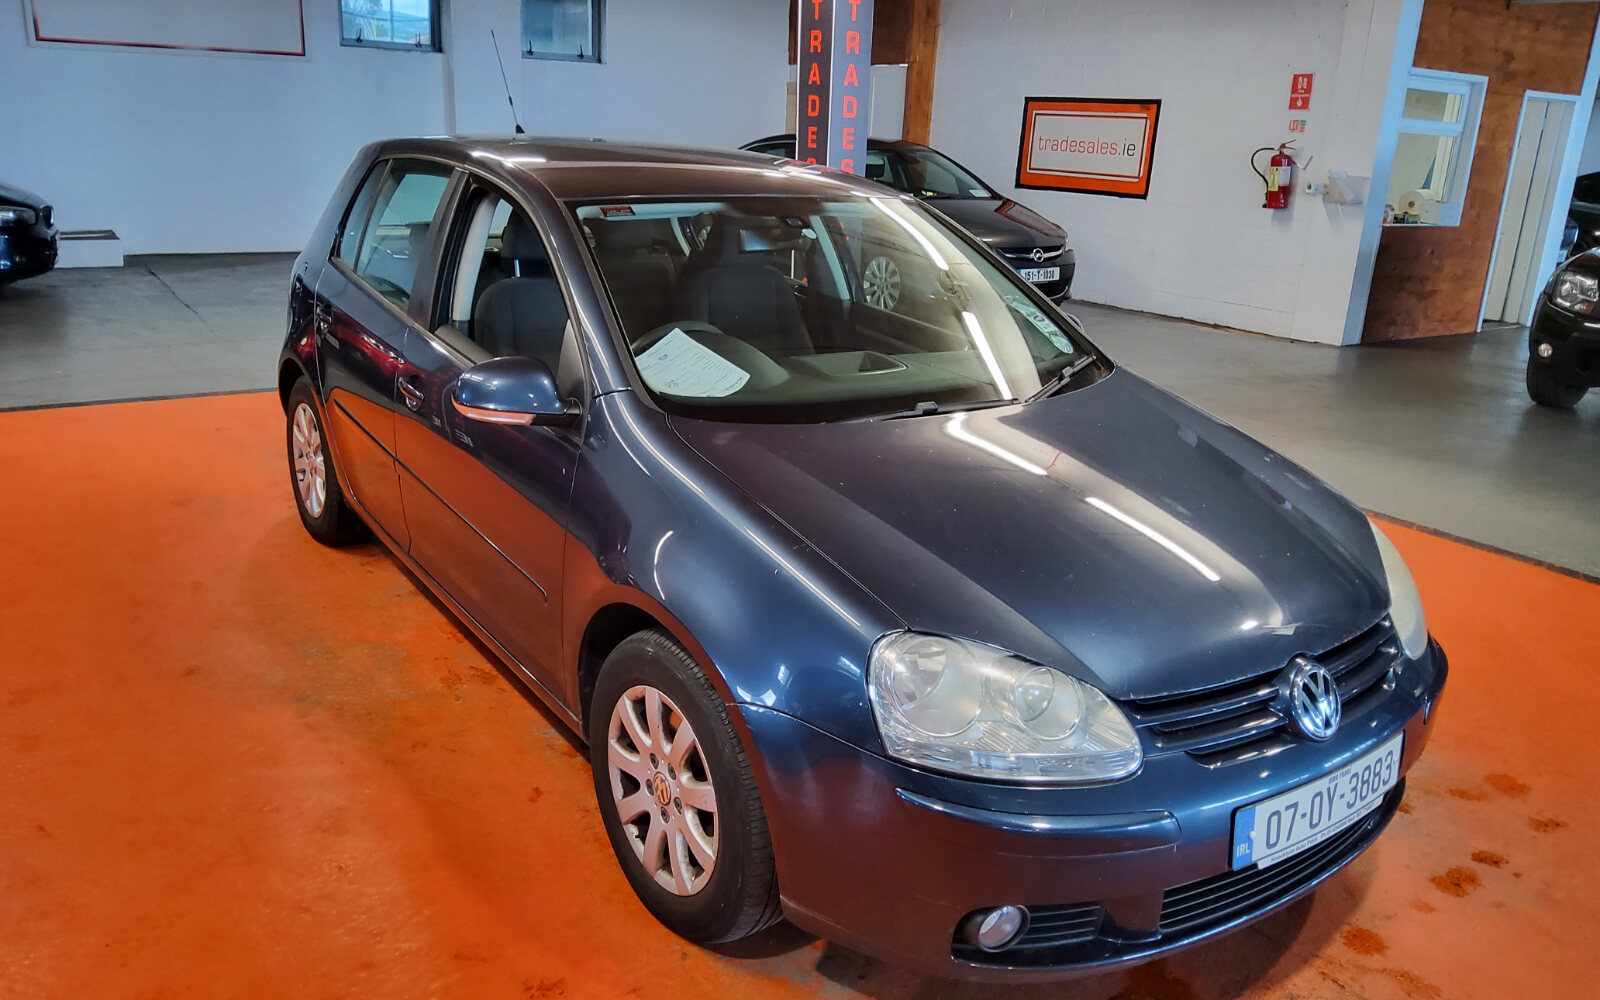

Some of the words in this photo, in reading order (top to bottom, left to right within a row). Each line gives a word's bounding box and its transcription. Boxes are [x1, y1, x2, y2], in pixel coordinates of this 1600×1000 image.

[806, 0, 823, 165] TRADE
[1038, 135, 1136, 157] tradesales.ie
[1265, 750, 1394, 850] 07-OY-3883
[1236, 842, 1251, 858] IRL
